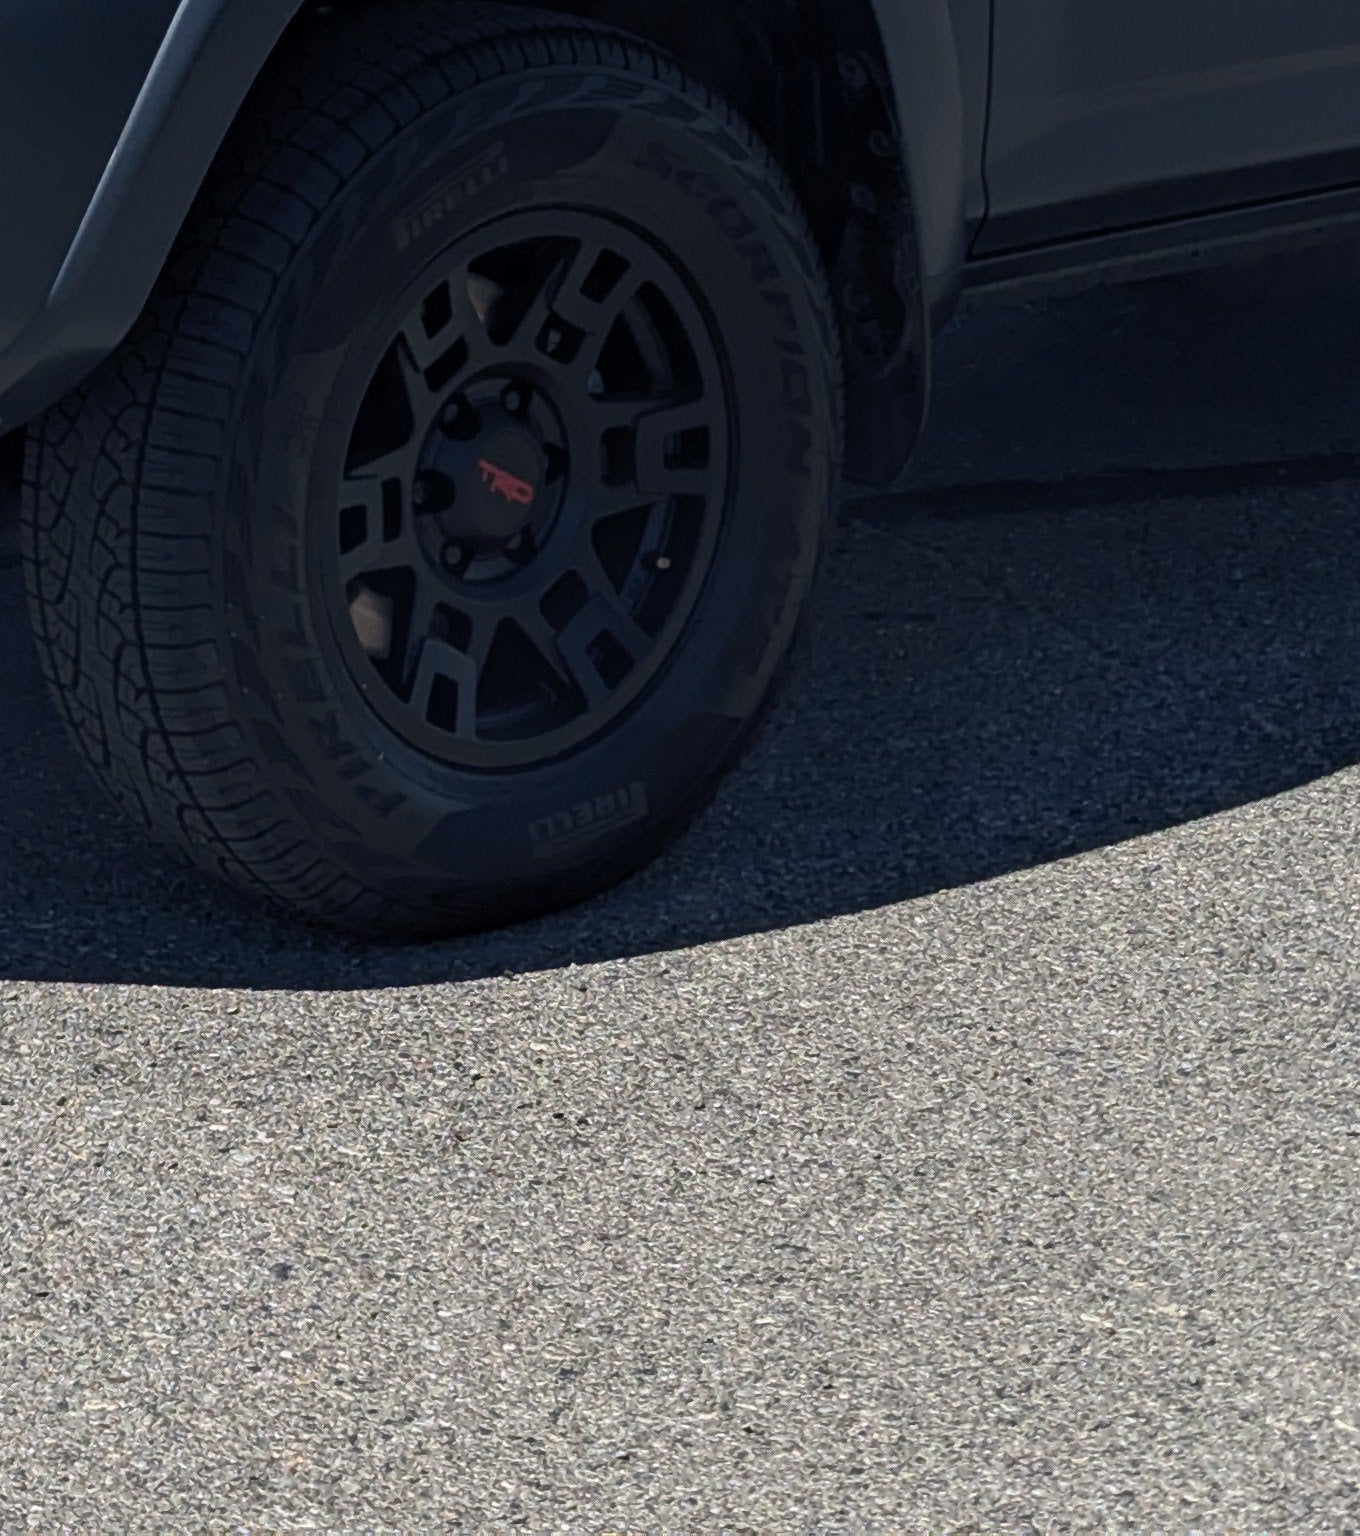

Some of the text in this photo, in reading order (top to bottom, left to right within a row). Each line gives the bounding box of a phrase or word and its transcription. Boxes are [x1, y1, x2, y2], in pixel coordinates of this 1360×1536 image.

[390, 140, 510, 252] PIRELLI
[478, 458, 534, 506] TRD
[269, 502, 408, 816] PIRELLI
[527, 778, 648, 860] PIRELLI
